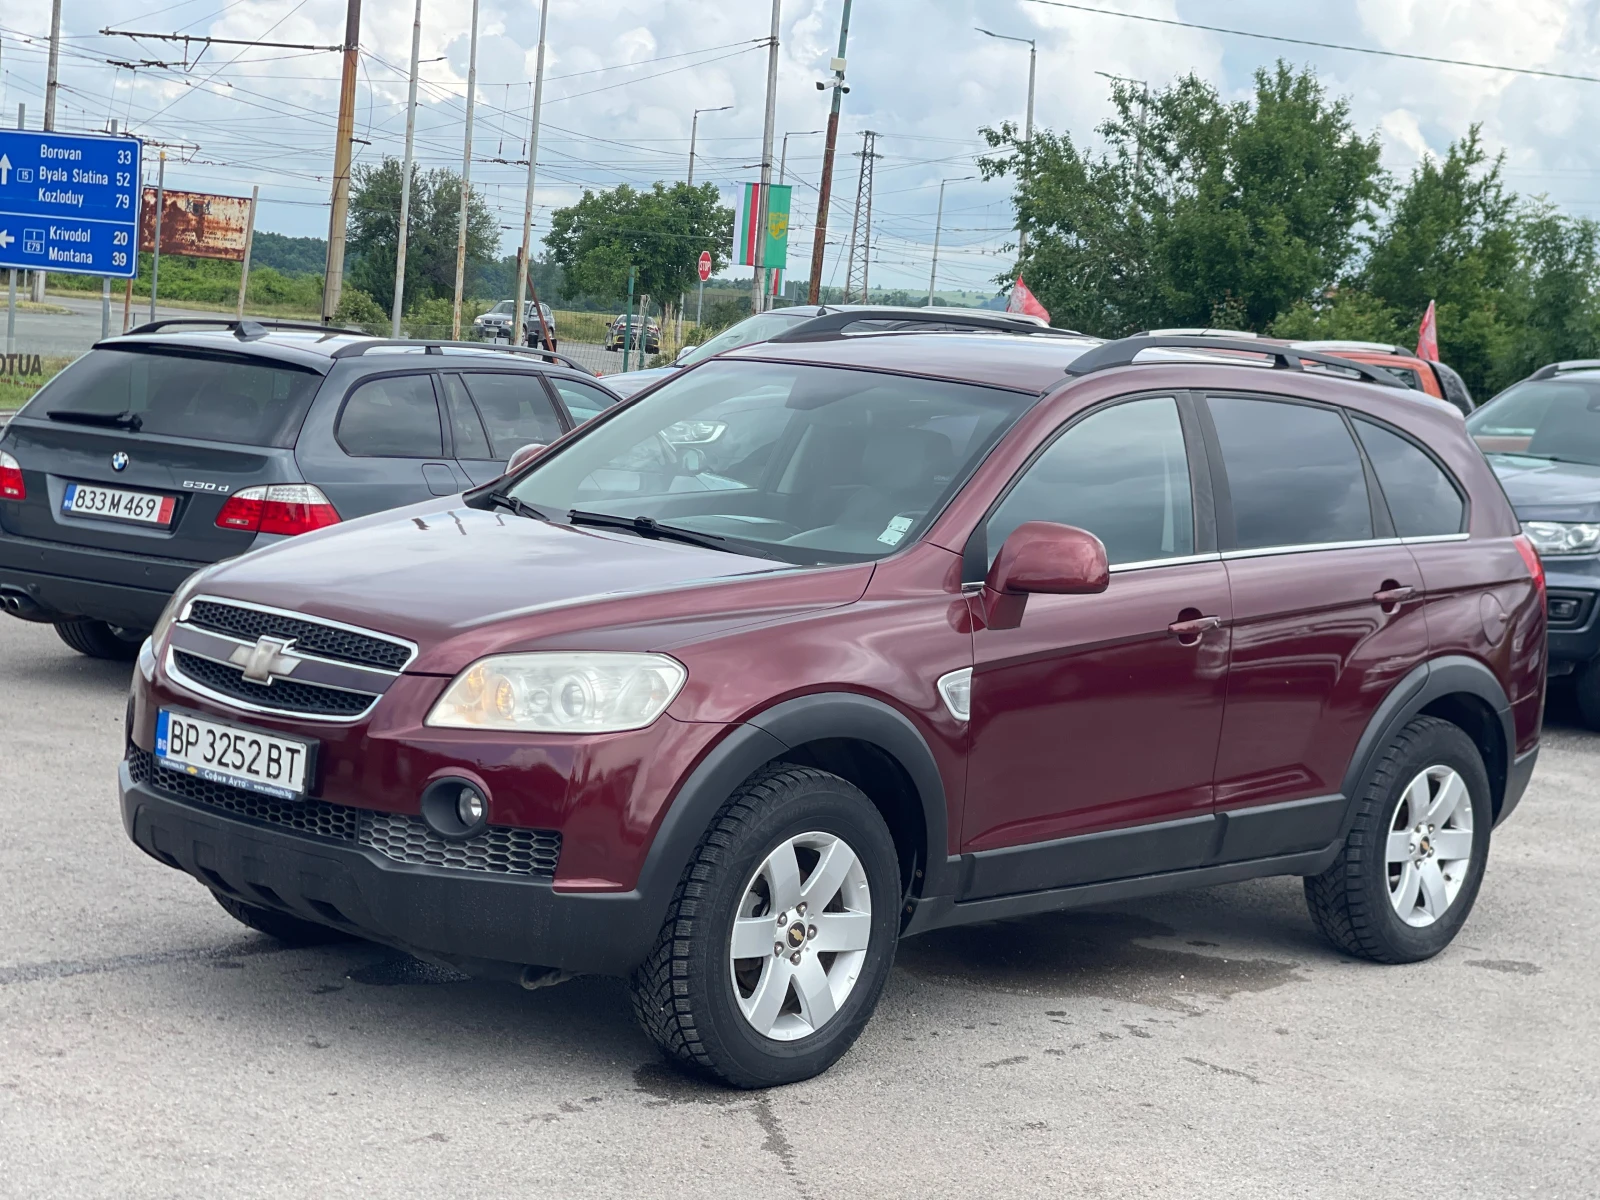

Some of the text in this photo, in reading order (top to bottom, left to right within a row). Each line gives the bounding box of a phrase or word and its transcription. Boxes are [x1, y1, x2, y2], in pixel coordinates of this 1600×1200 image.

[40, 144, 132, 165] Borovan 33
[21, 170, 29, 180] 15
[39, 166, 131, 187] Byala Slatina 52
[38, 187, 130, 209] Kozloduy 79
[49, 225, 128, 246] Krivodol 20
[26, 242, 41, 252] E79
[48, 246, 127, 267] Montana 39
[700, 260, 711, 272] STOP
[182, 480, 216, 491] 530
[157, 738, 167, 750] BG
[203, 729, 262, 775] 3252
